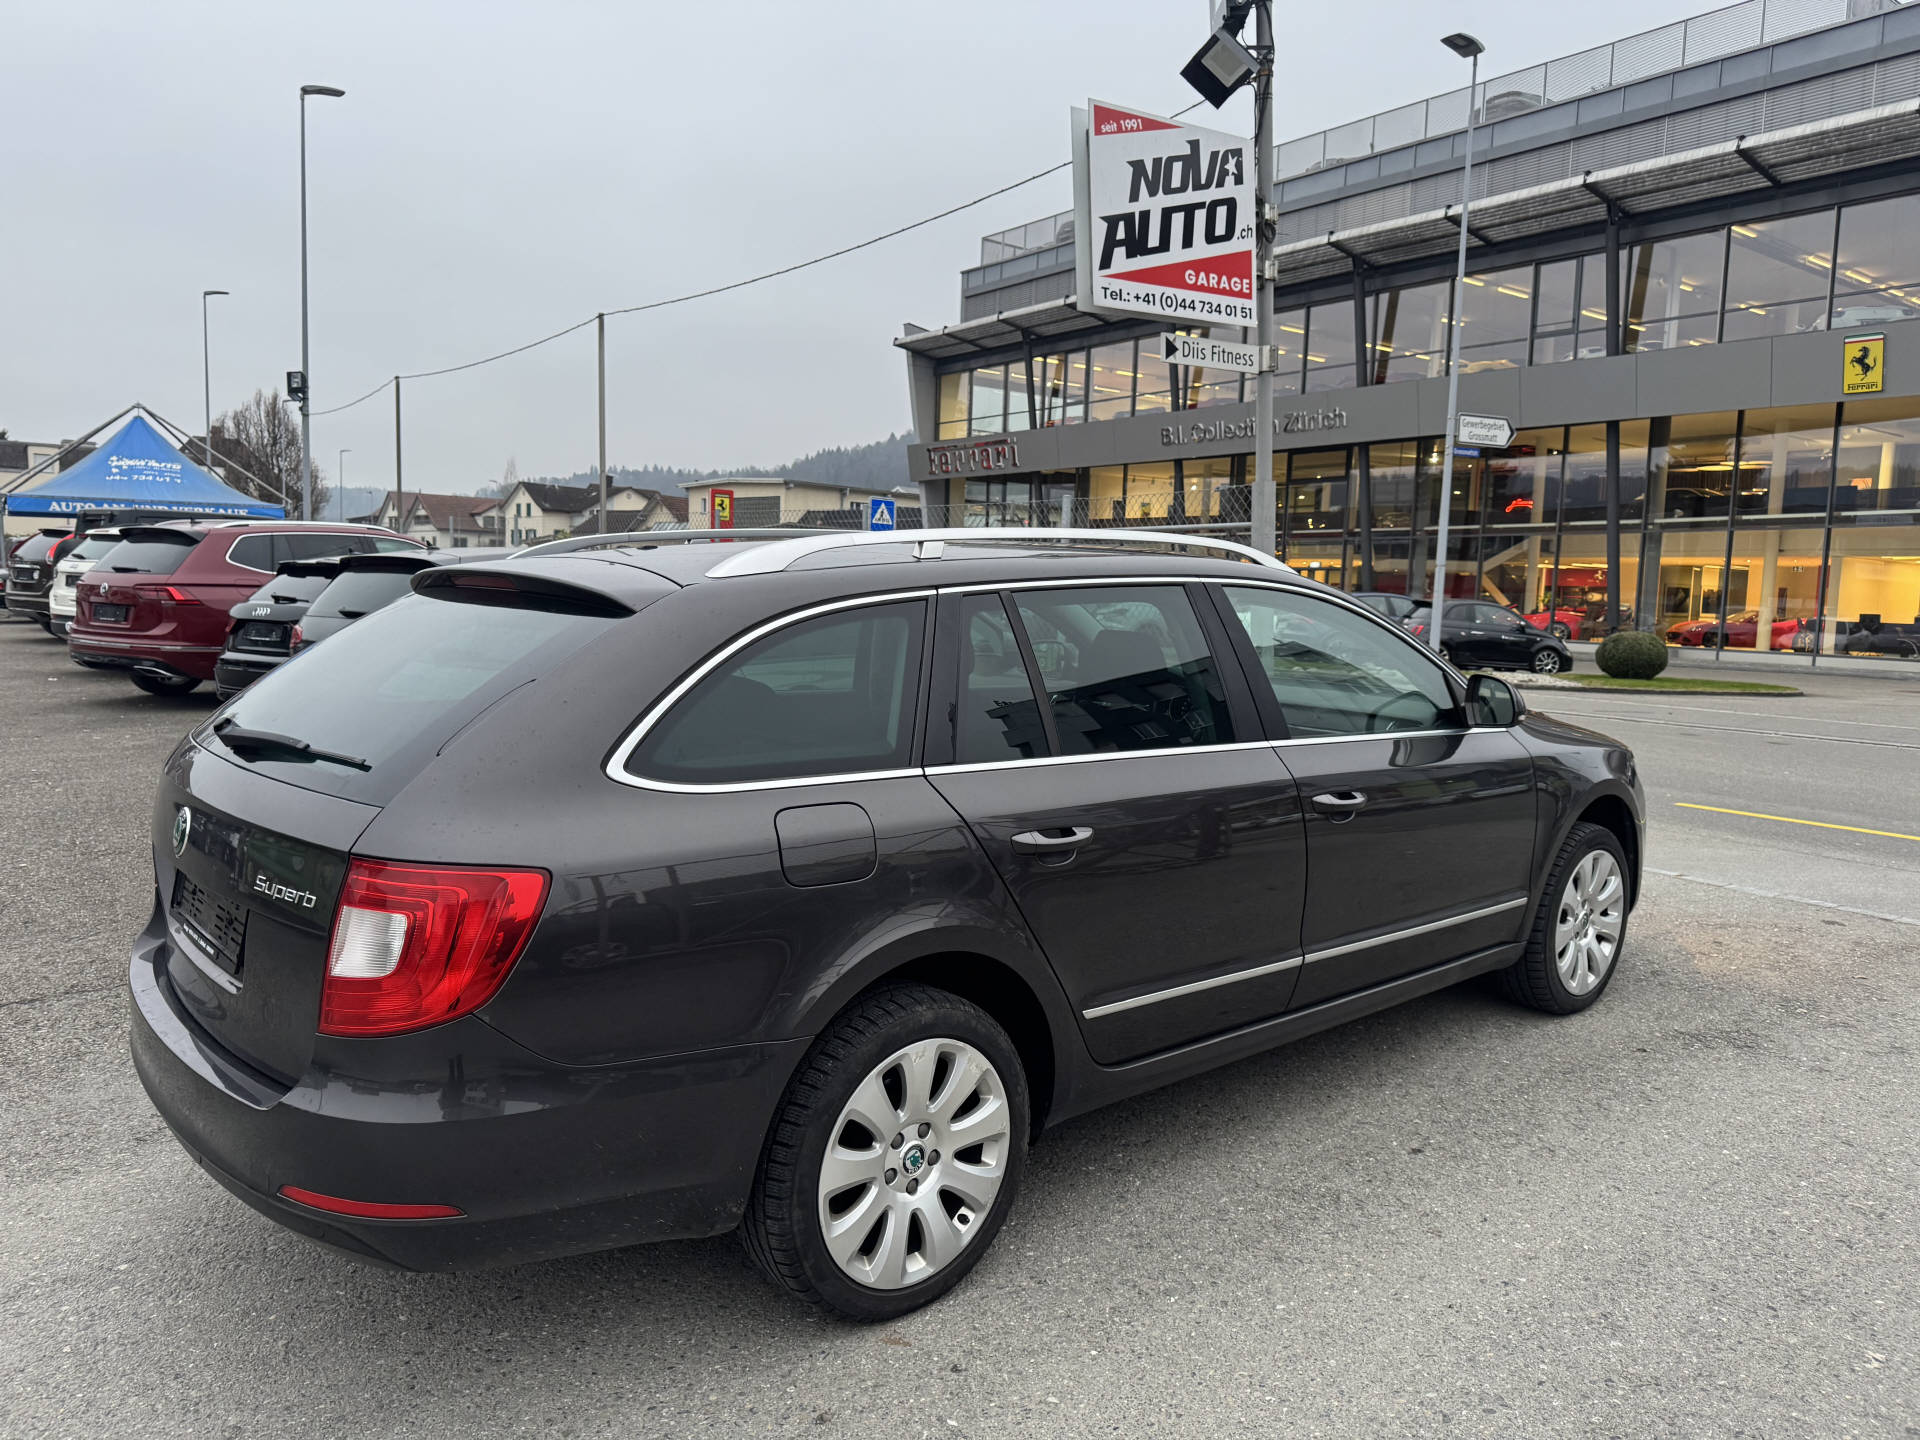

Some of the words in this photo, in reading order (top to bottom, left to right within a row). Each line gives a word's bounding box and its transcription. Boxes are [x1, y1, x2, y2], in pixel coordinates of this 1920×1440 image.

[1101, 120, 1117, 132] seit
[1120, 118, 1143, 131] 1991
[1127, 138, 1244, 203] NOVA
[1099, 197, 1237, 271] AUTO
[1185, 270, 1250, 293] GARAGE
[1101, 287, 1131, 302] Tel.:
[1134, 293, 1156, 306] +41
[1200, 301, 1222, 316] 734
[1225, 305, 1237, 317] 01
[1241, 307, 1252, 319] 51
[1182, 341, 1206, 360] Diis
[1211, 346, 1254, 367] Fitness
[1847, 382, 1878, 391] Ferrari
[1191, 415, 1279, 443] Collectin
[1283, 407, 1347, 433] Zürich
[927, 437, 1020, 474] Ferrari
[254, 875, 317, 909] Superb
